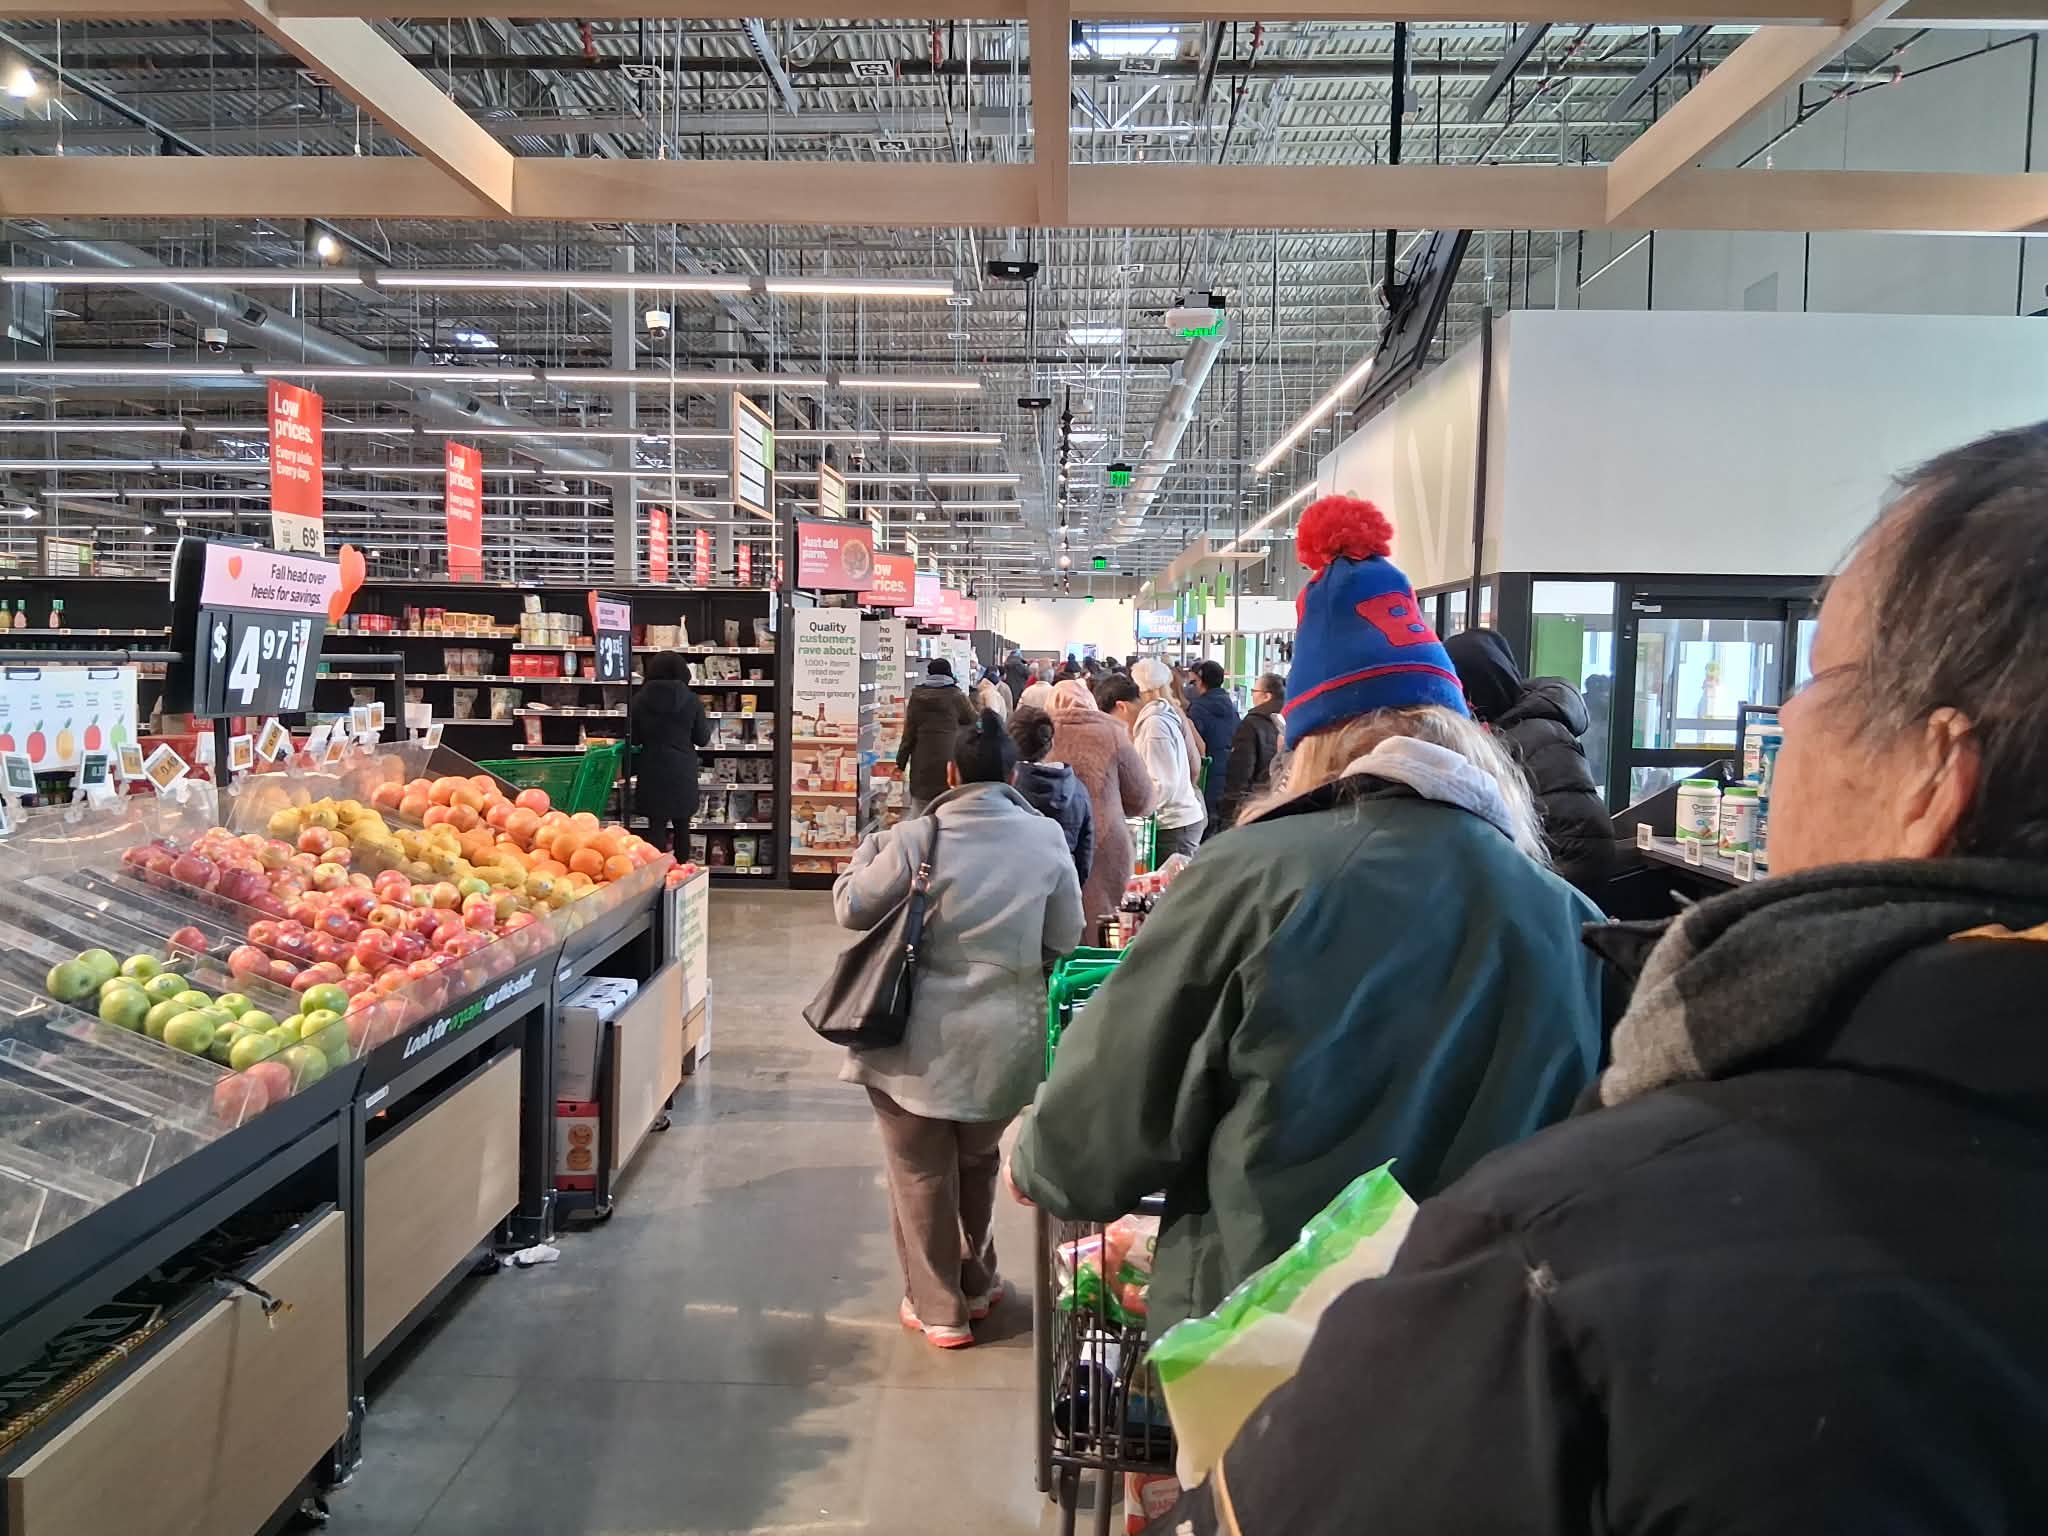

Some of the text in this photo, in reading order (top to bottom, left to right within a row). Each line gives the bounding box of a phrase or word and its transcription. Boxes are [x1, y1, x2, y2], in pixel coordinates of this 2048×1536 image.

[275, 391, 299, 418] Low
[275, 417, 314, 444] prices.
[803, 536, 839, 549] Just add
[271, 564, 327, 585] Fall head over
[873, 565, 892, 576] ow
[872, 577, 907, 592] rices.
[251, 583, 321, 607] heels for savings.
[809, 621, 847, 634] Quality
[880, 625, 890, 634] ho
[799, 633, 857, 644] customers
[798, 645, 857, 655] rave about.
[826, 691, 857, 699] grocery
[403, 1024, 433, 1060] Look
[448, 995, 487, 1032] organic
